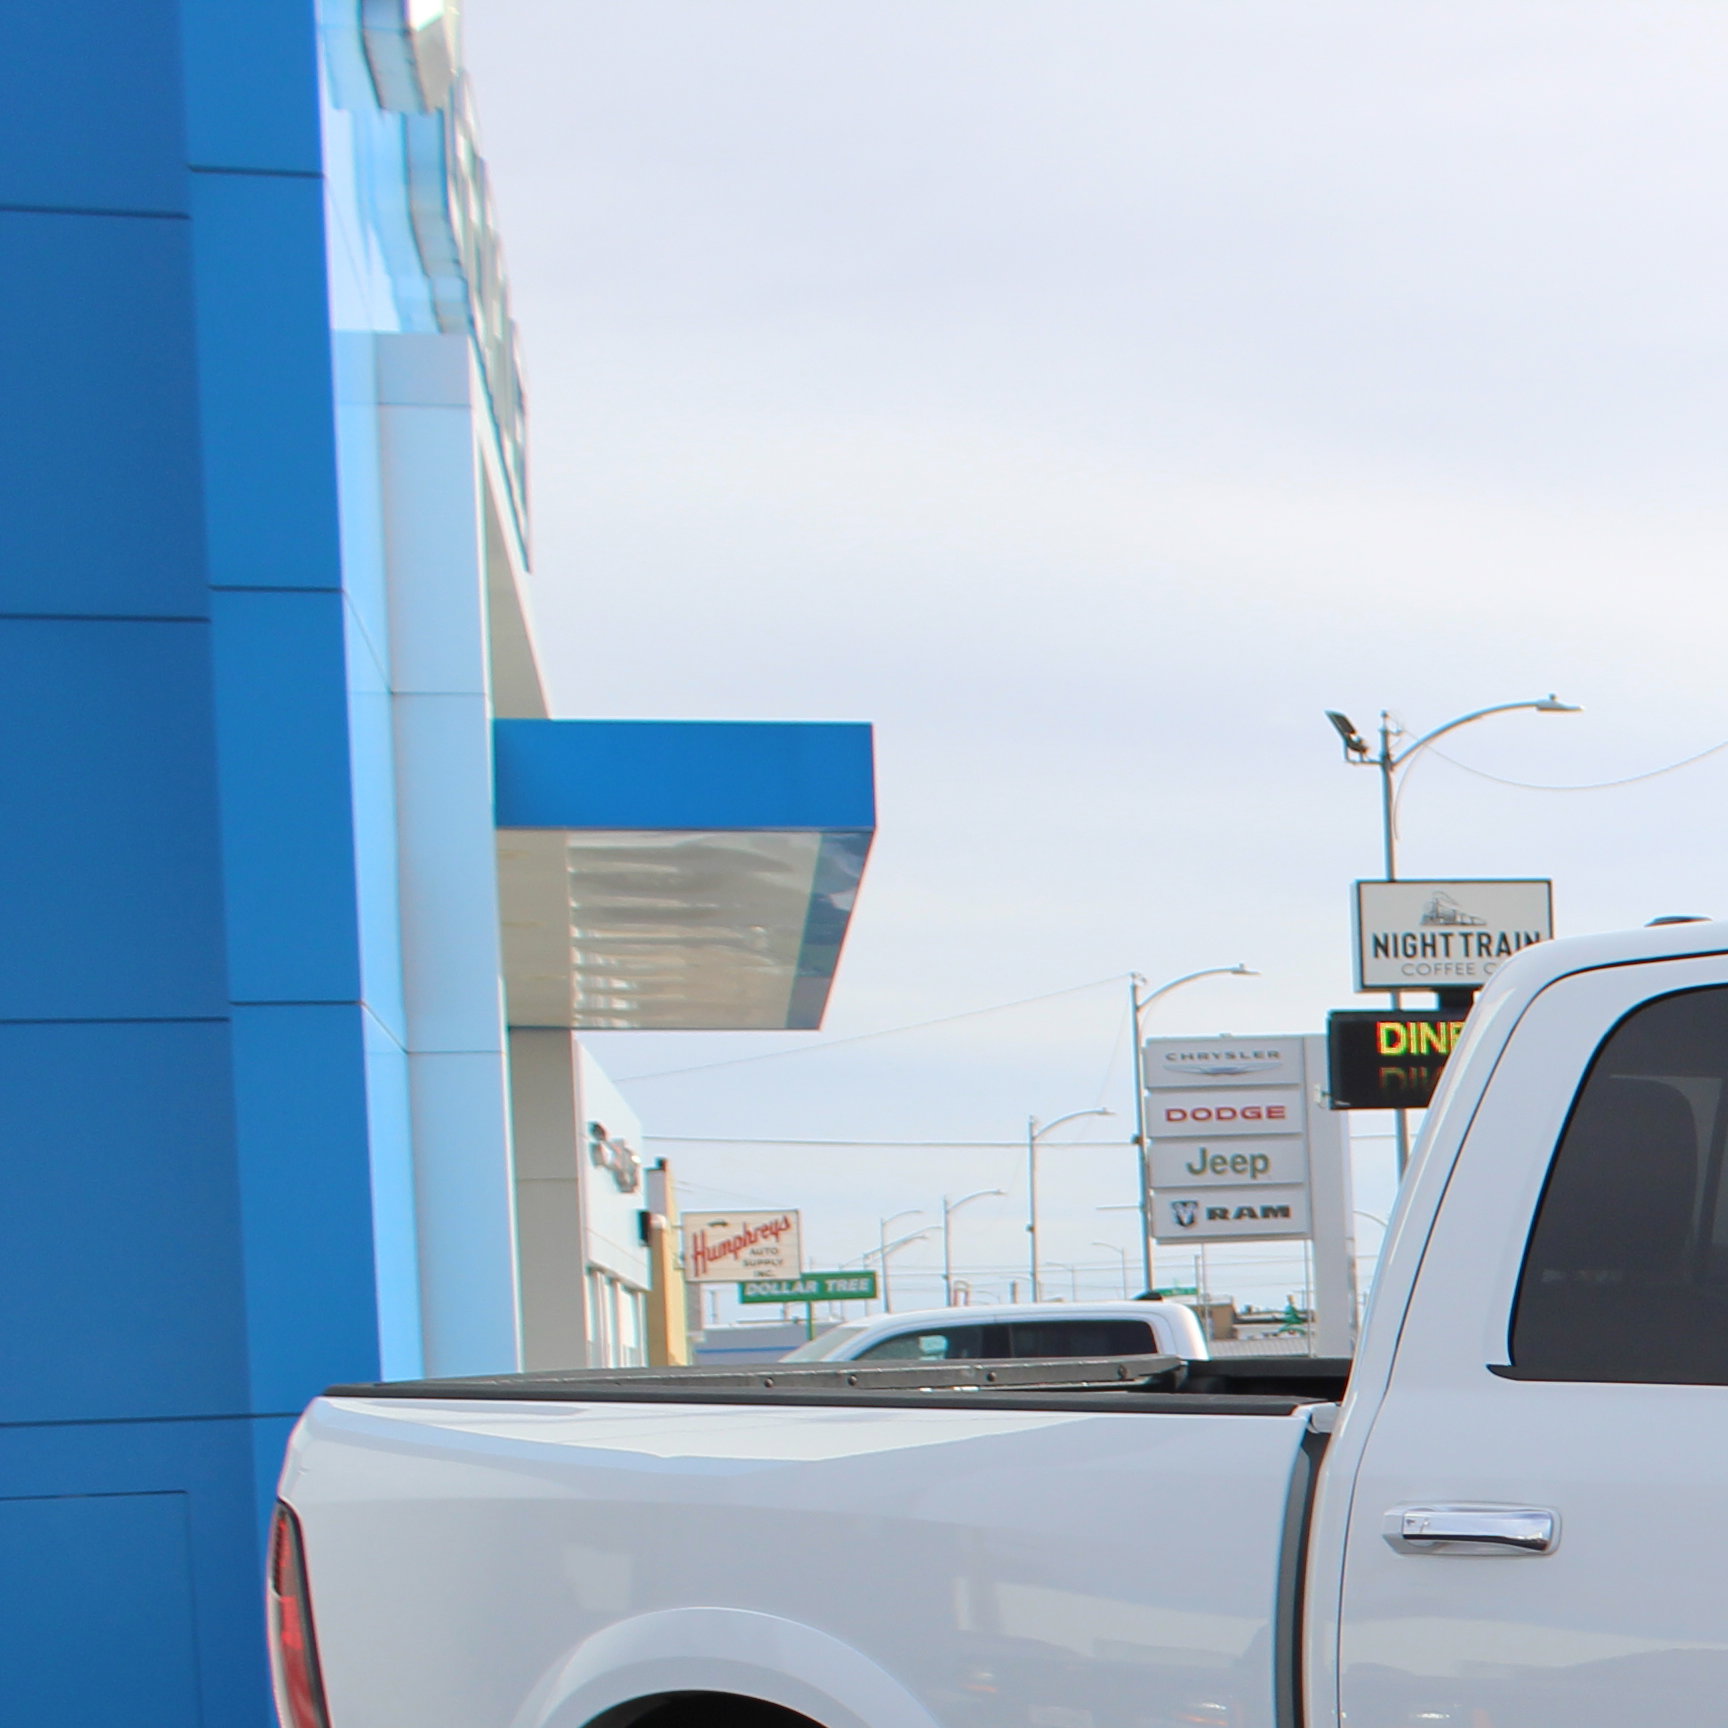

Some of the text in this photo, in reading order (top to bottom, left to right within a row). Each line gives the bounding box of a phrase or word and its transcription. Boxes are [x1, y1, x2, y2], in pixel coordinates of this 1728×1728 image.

[1372, 931, 1457, 959] NIGHT
[1401, 962, 1498, 977] COFFEE C
[1165, 1050, 1281, 1062] CHRYSLER
[1165, 1105, 1287, 1122] DODGE
[1186, 1146, 1271, 1179] Jeep
[1206, 1204, 1292, 1221] RAM
[692, 1215, 791, 1278] Humphreys
[749, 1247, 779, 1256] AUTO
[742, 1257, 784, 1267] SUPPLY
[744, 1278, 870, 1296] DOLLAR TREE
